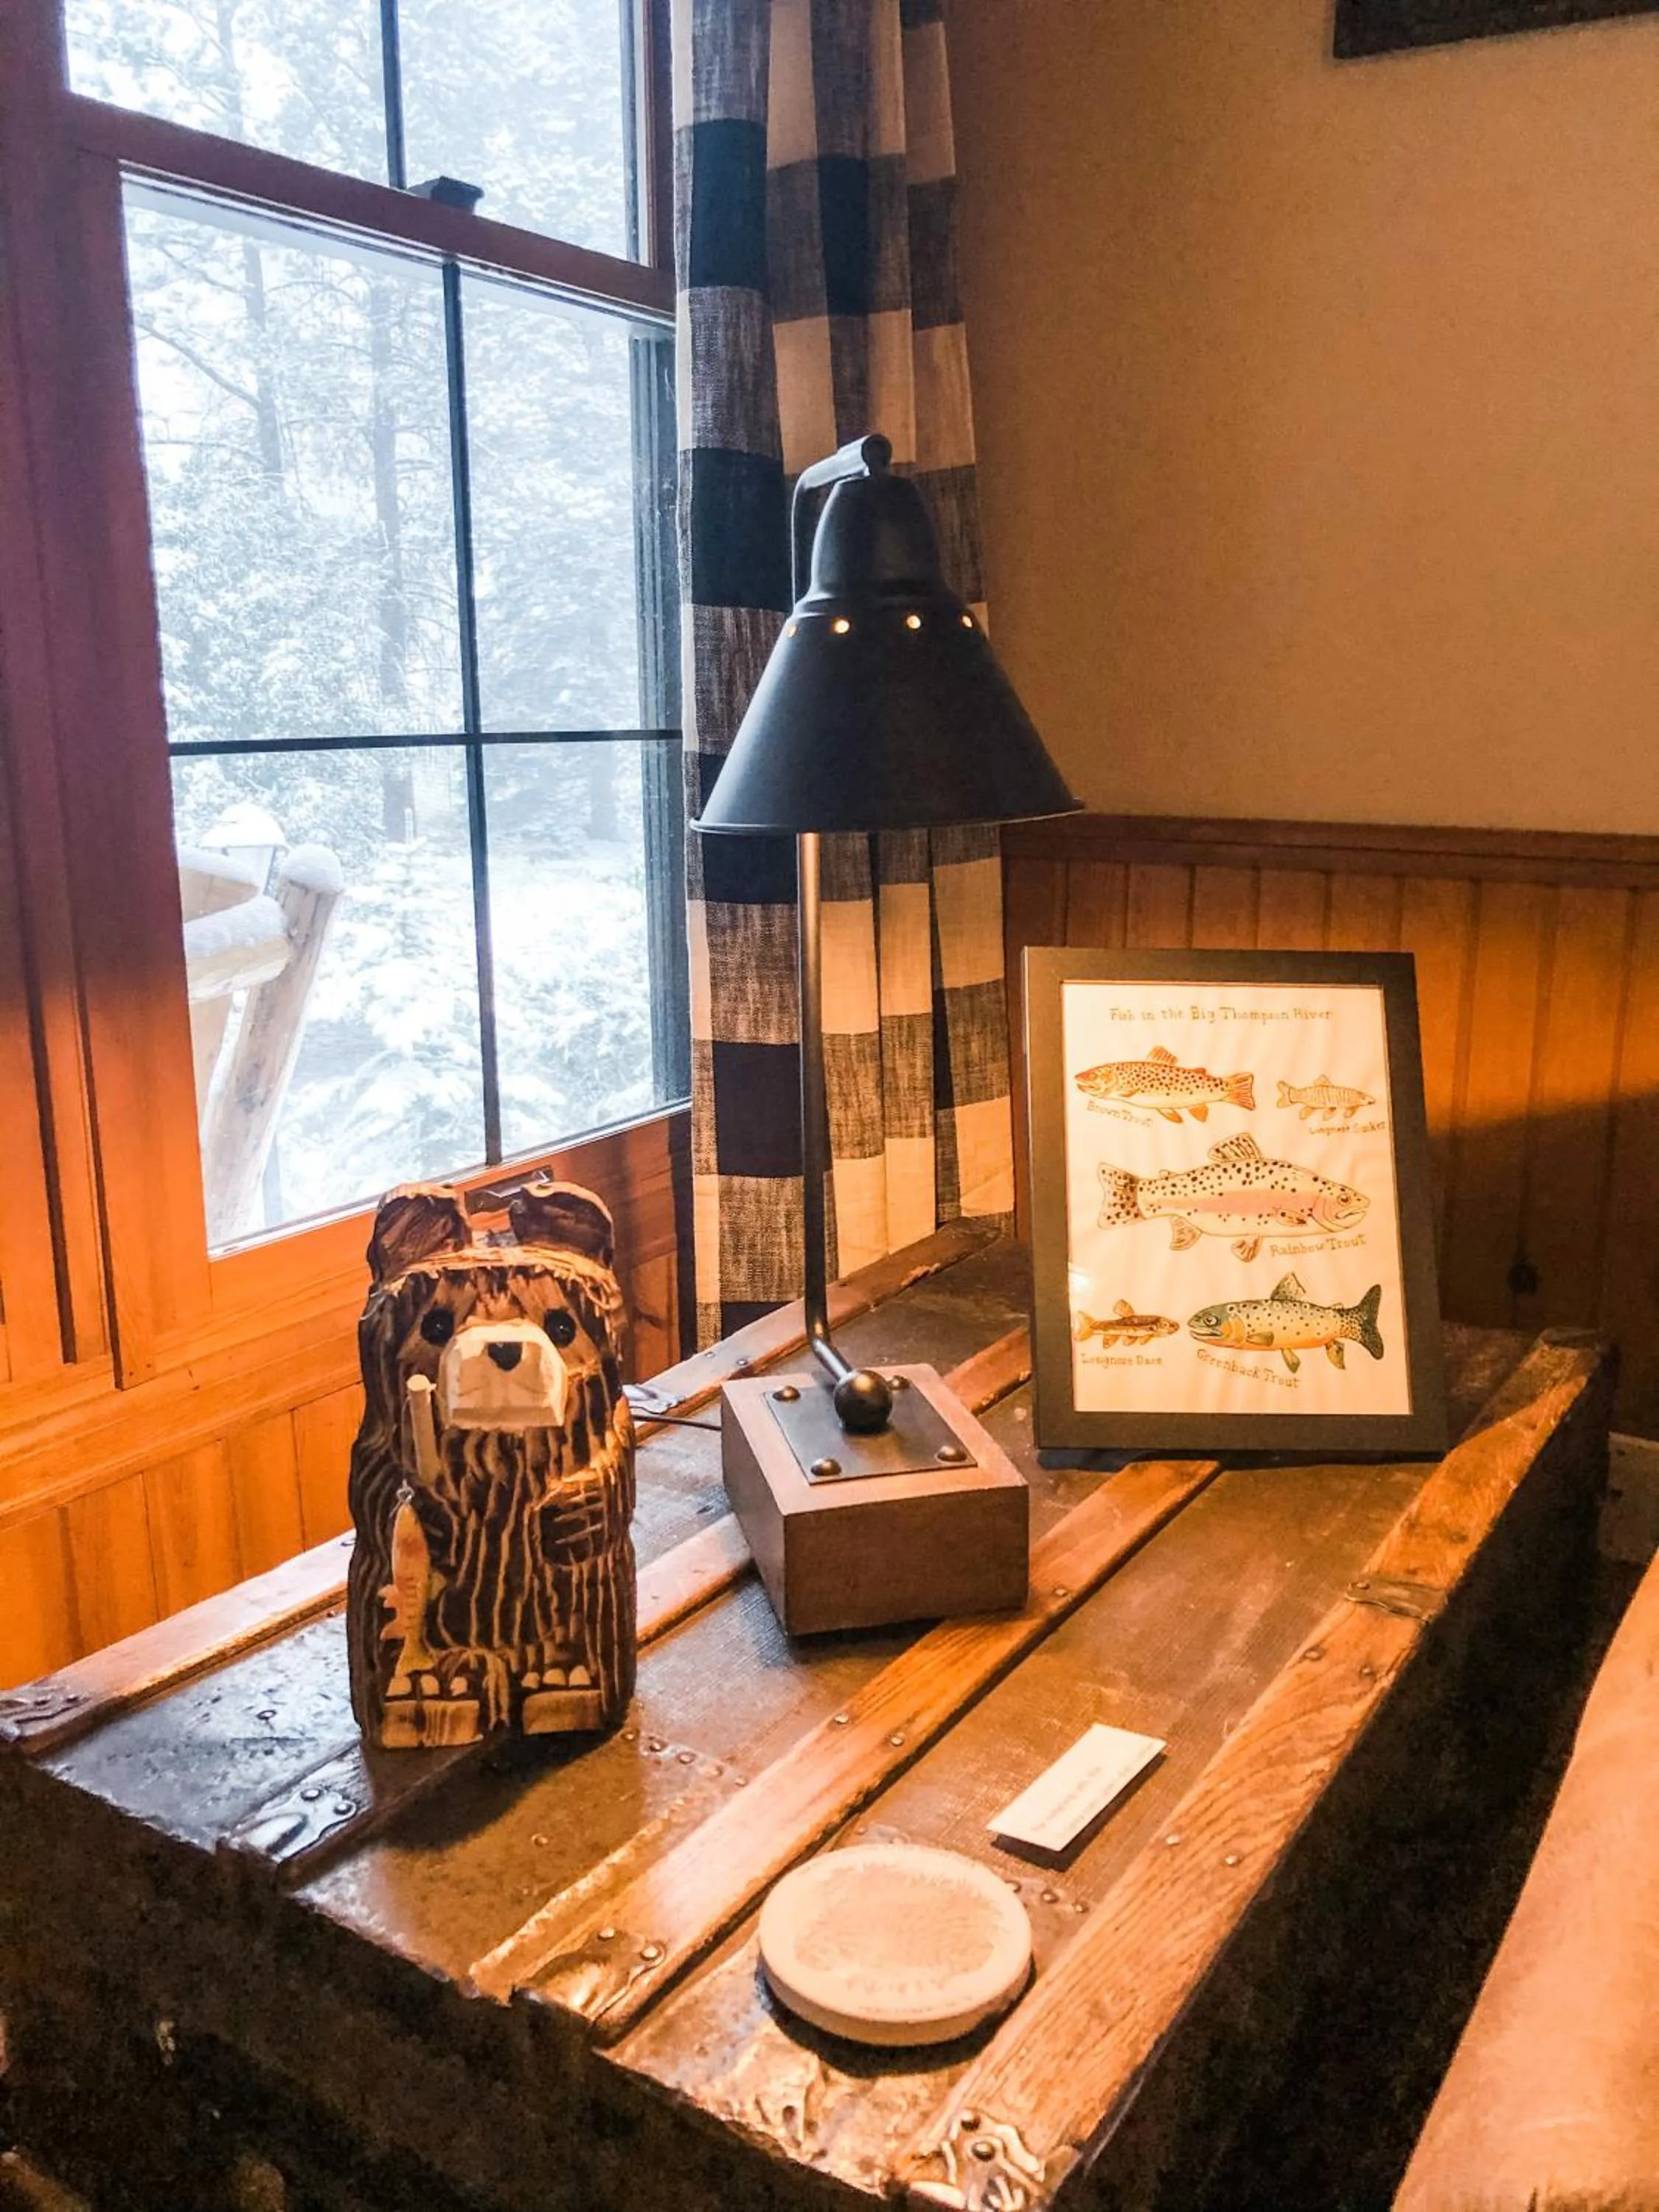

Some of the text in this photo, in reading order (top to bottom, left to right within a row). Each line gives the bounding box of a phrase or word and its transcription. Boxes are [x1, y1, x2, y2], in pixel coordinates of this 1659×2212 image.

[1110, 1006, 1333, 1024] Fish in the Big Thompson River
[1270, 1234, 1366, 1257] Rainbow Trout
[1197, 1348, 1301, 1388] Greenback Trout
